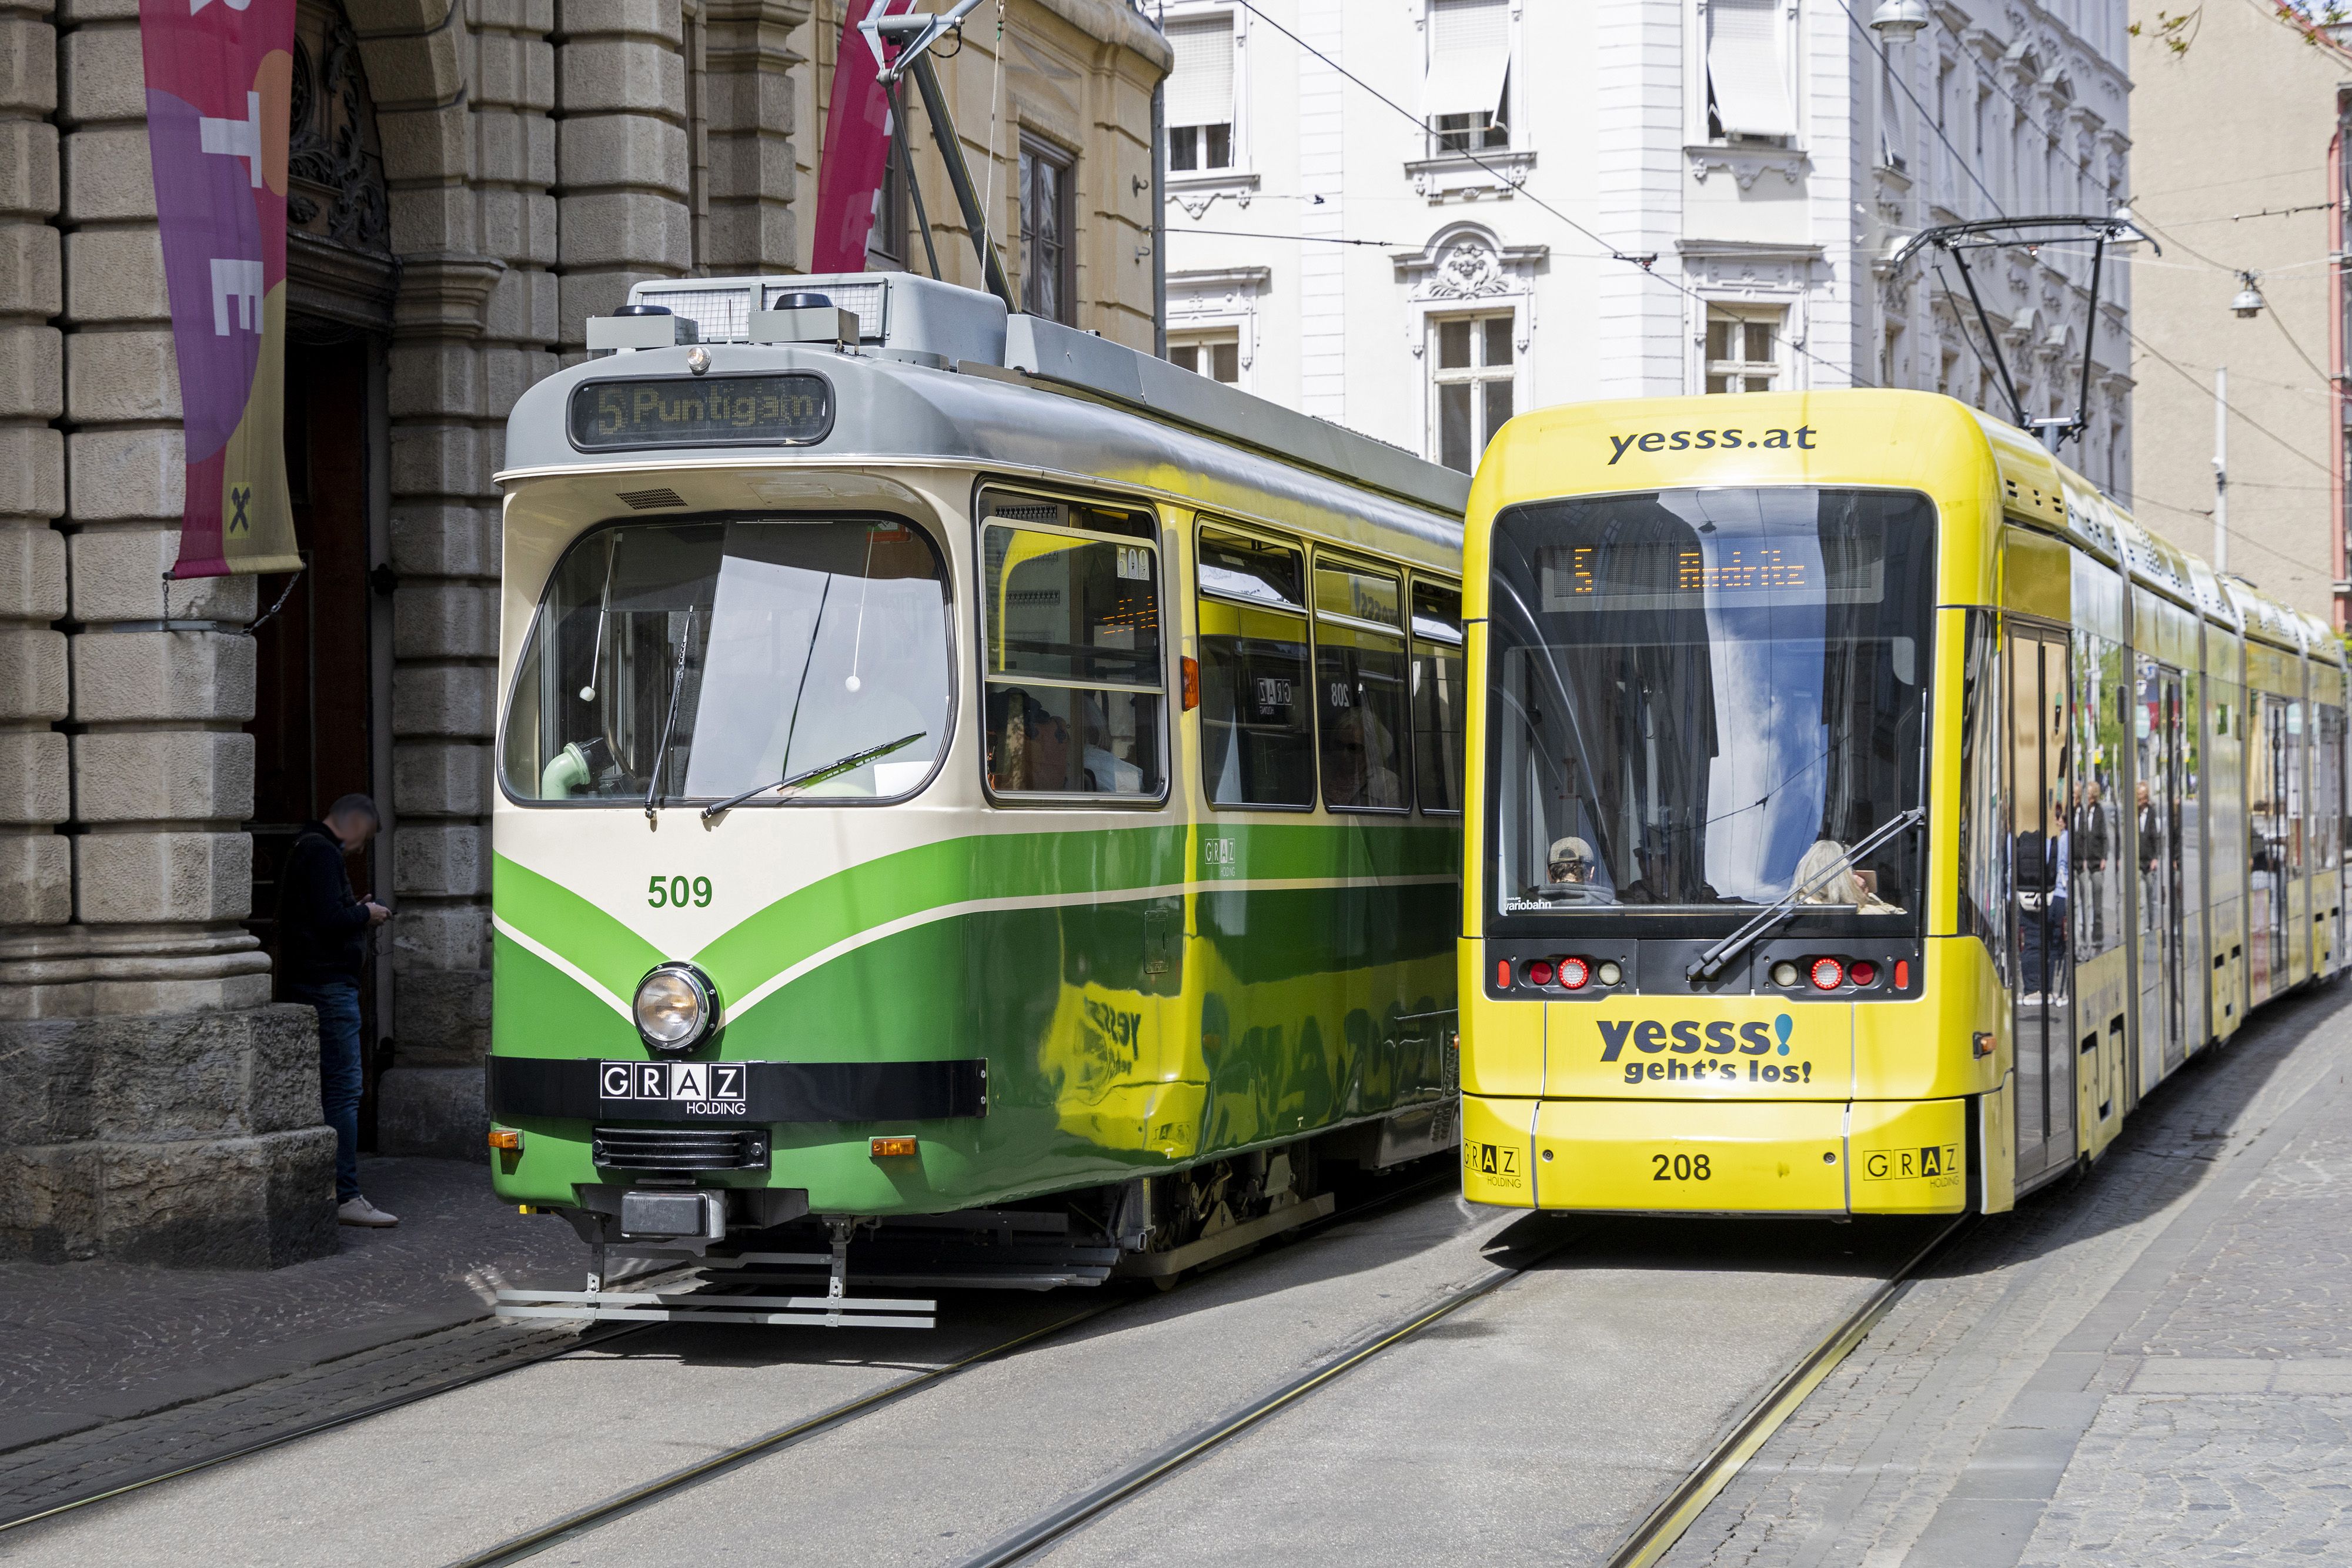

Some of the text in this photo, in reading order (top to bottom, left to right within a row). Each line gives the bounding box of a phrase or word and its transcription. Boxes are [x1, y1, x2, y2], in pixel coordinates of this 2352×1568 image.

[599, 387, 622, 434] 5
[1607, 424, 1817, 465] yesss.at
[1118, 547, 1148, 579] 509
[1205, 841, 1234, 863] GRAZ
[647, 875, 713, 908] 509
[1504, 899, 1552, 911] variobahn
[1596, 1013, 1793, 1062] yesss!
[603, 1065, 740, 1098] GRAZ
[1749, 1059, 1812, 1084] los!
[686, 1102, 746, 1115] HOLDING
[1464, 1142, 1516, 1174] GRAZ
[1652, 1154, 1712, 1181] 208
[1867, 1148, 1956, 1177] GRAZ
[1487, 1176, 1522, 1188] HOLDING
[1930, 1176, 1959, 1188] HOLDING
